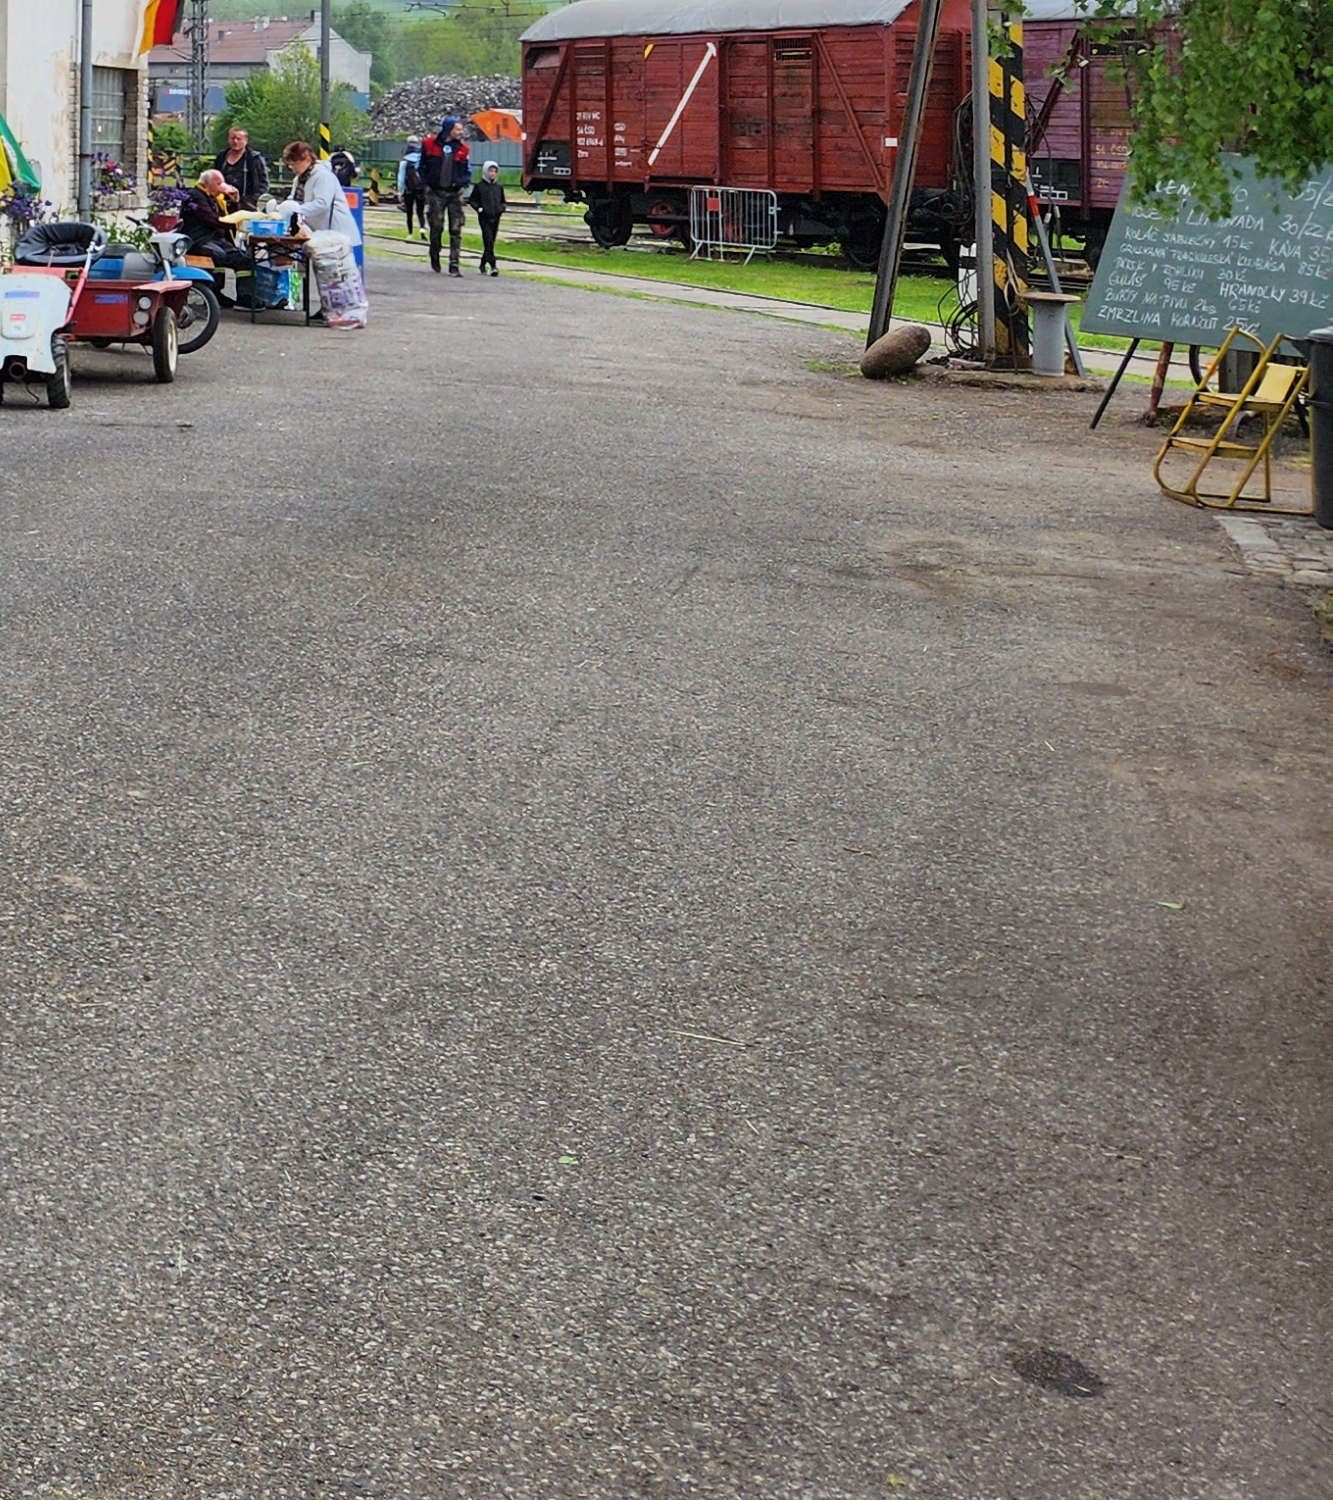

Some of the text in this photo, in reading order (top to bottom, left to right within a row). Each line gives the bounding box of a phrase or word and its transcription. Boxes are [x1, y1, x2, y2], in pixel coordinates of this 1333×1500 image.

[1125, 225, 1160, 242] KOLÁČ
[1268, 238, 1301, 259] KÁVA
[1108, 270, 1148, 287] GULÁŠ
[1141, 292, 1158, 305] NA
[1159, 294, 1188, 309] PIVU
[1097, 305, 1161, 326] ZMRZLINA
